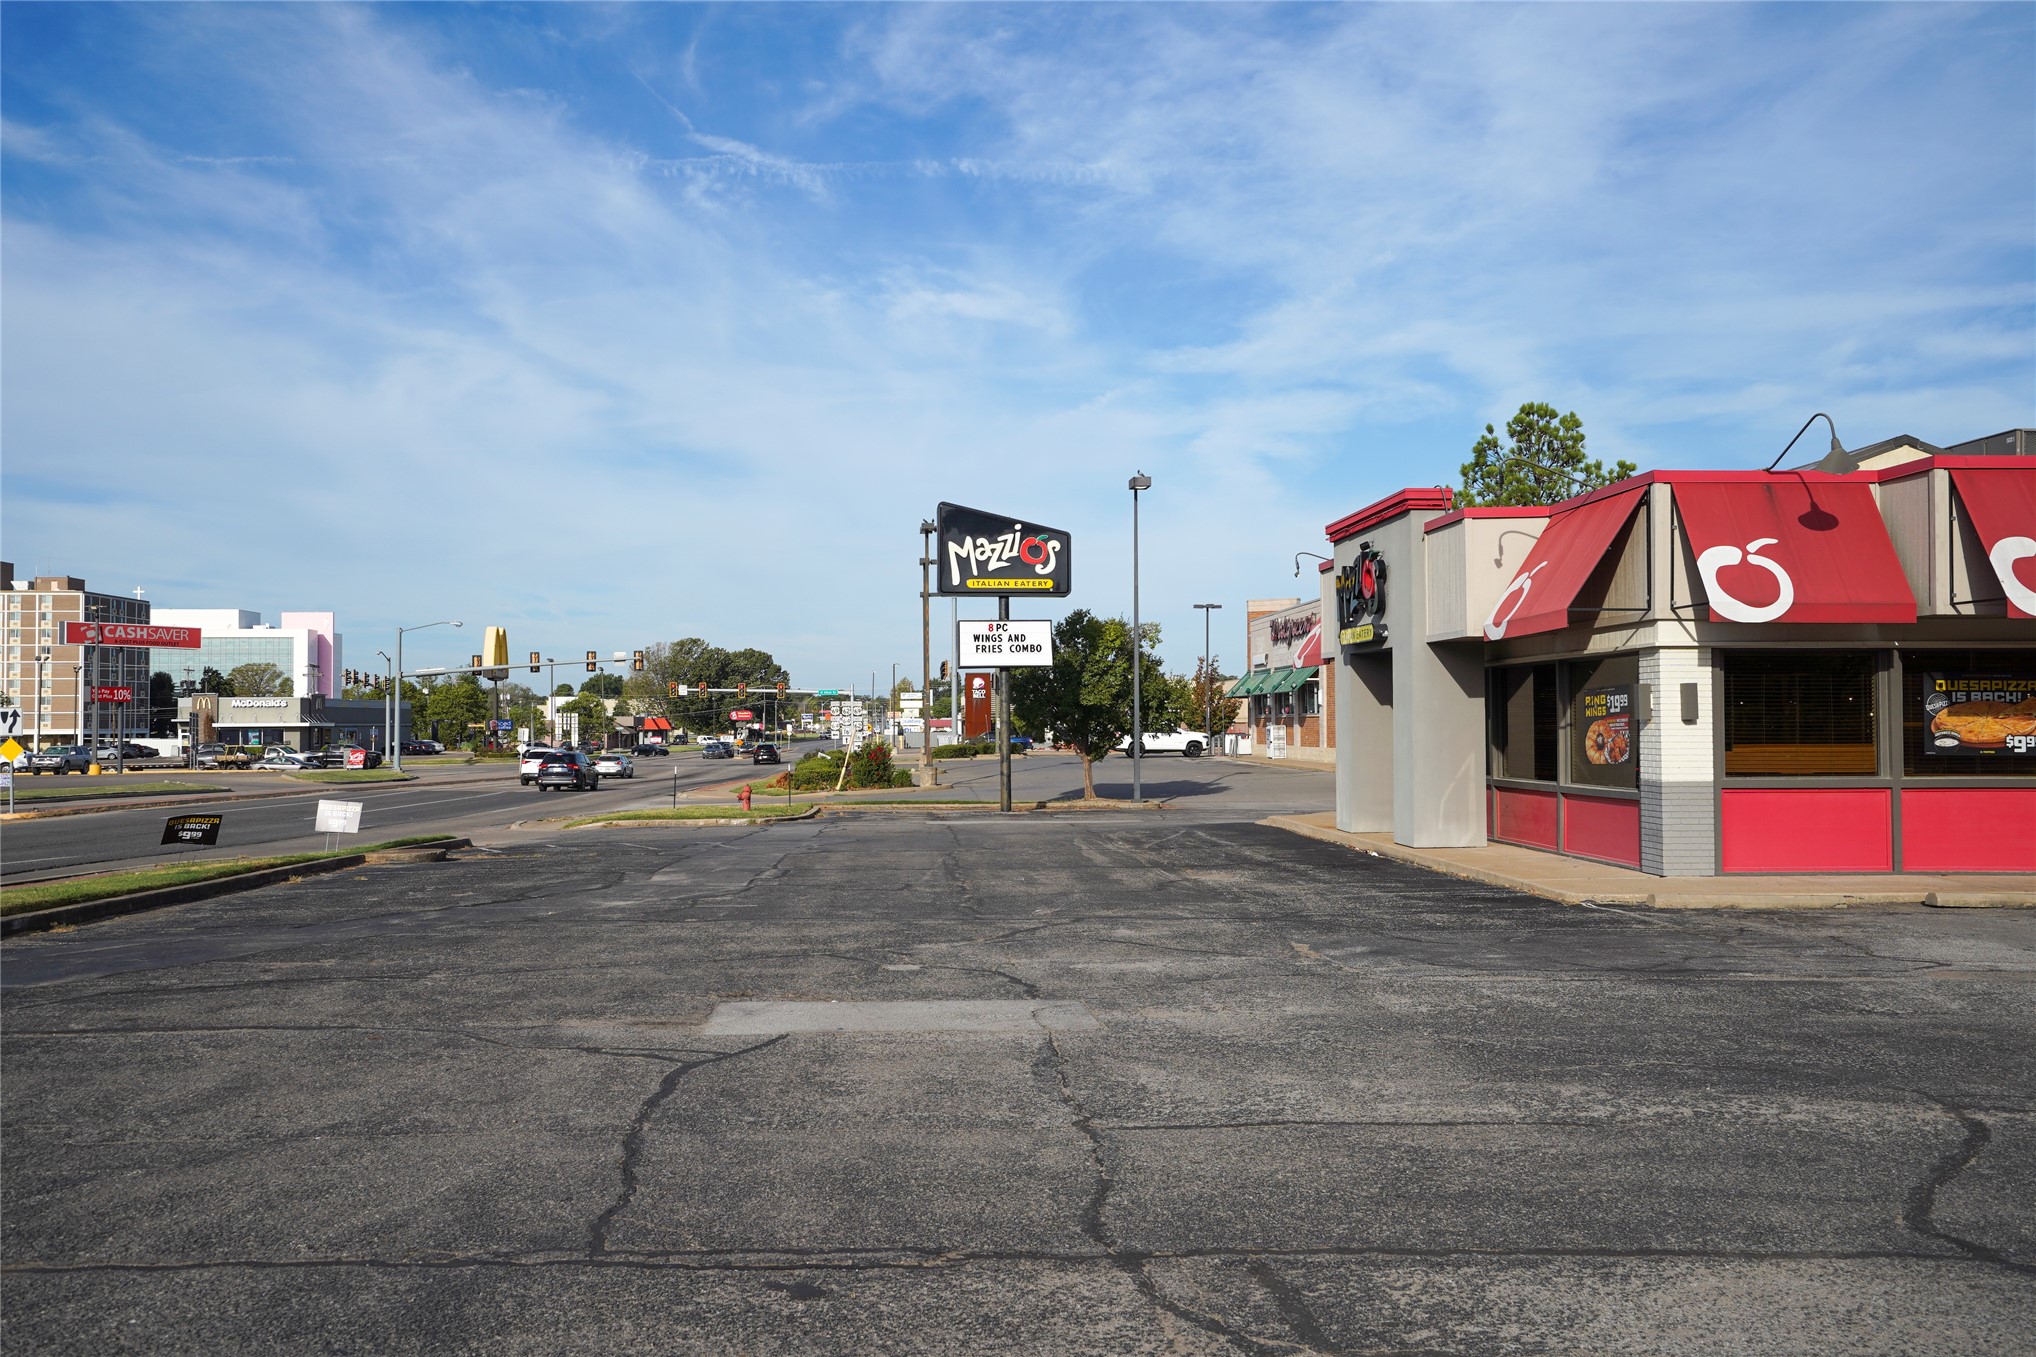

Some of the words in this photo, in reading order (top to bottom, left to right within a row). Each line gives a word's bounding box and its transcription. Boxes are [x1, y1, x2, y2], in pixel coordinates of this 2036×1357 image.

[988, 623, 994, 631] 8
[996, 623, 1008, 631] PC
[973, 634, 1003, 642] WINGS
[1008, 634, 1026, 642] AND
[975, 644, 1003, 653] FRIES
[1009, 644, 1042, 653] COMBO
[113, 689, 131, 700] 10%
[1952, 692, 1967, 702] IS
[1970, 692, 2021, 702] BACK!
[231, 699, 288, 708] McDonald's
[1585, 706, 1607, 717] WINGS
